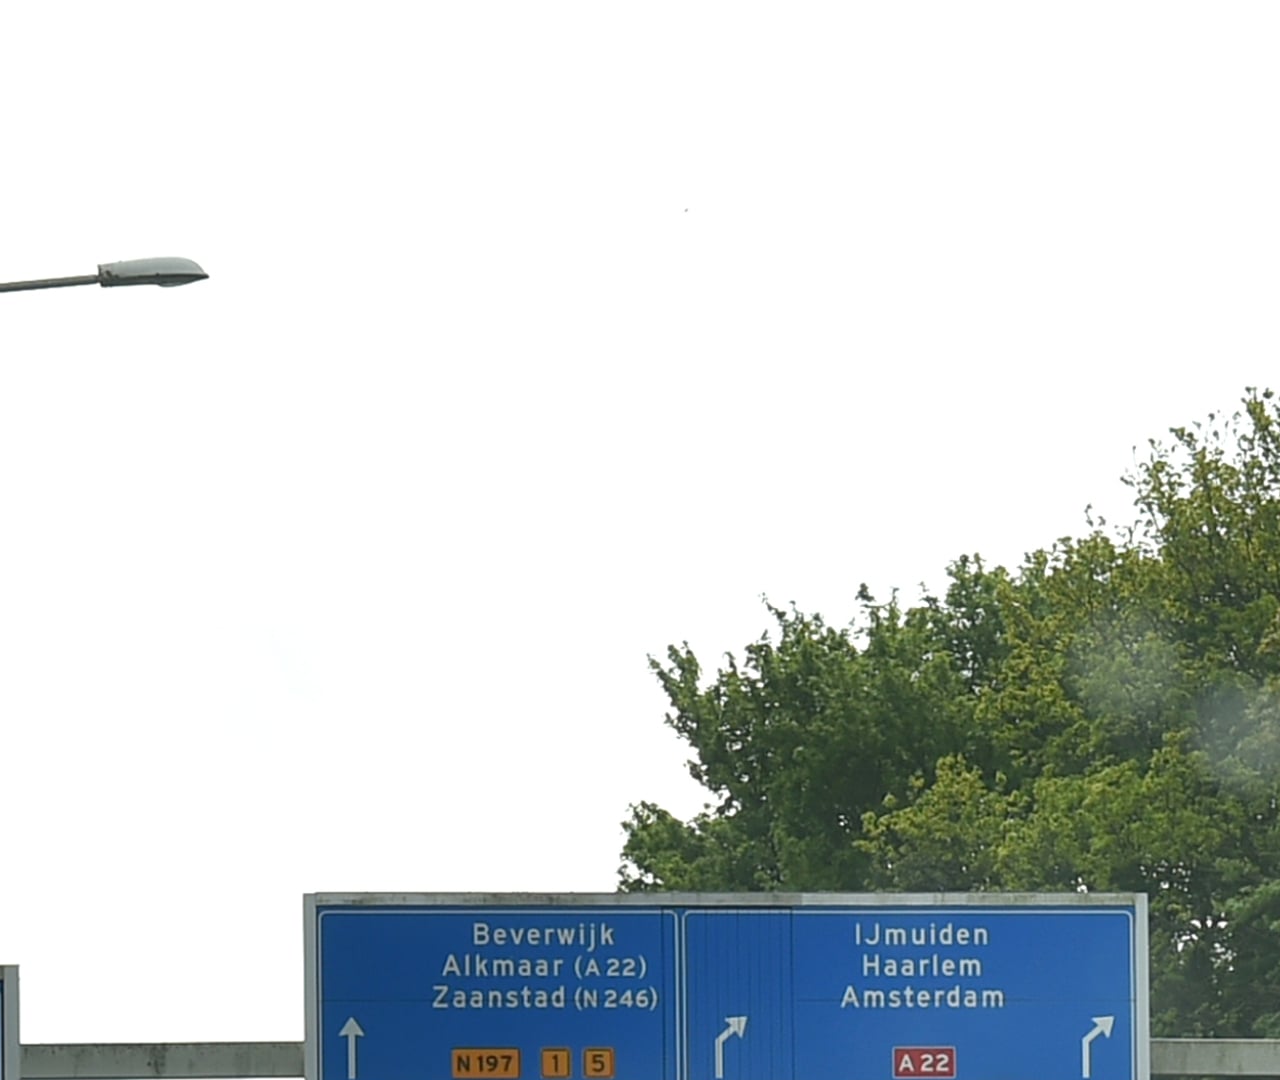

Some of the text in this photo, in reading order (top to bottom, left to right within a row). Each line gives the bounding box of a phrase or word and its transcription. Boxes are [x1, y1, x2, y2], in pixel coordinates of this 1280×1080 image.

[473, 923, 615, 952] Beverwijk
[855, 922, 988, 946] IJmuiden
[442, 954, 563, 977] Alkmaar
[862, 953, 982, 977] Haarlem
[432, 985, 566, 1009] Zaanstad
[840, 984, 1004, 1009] Amsterdam
[551, 1054, 560, 1073] 1
[591, 1054, 606, 1073] 5
